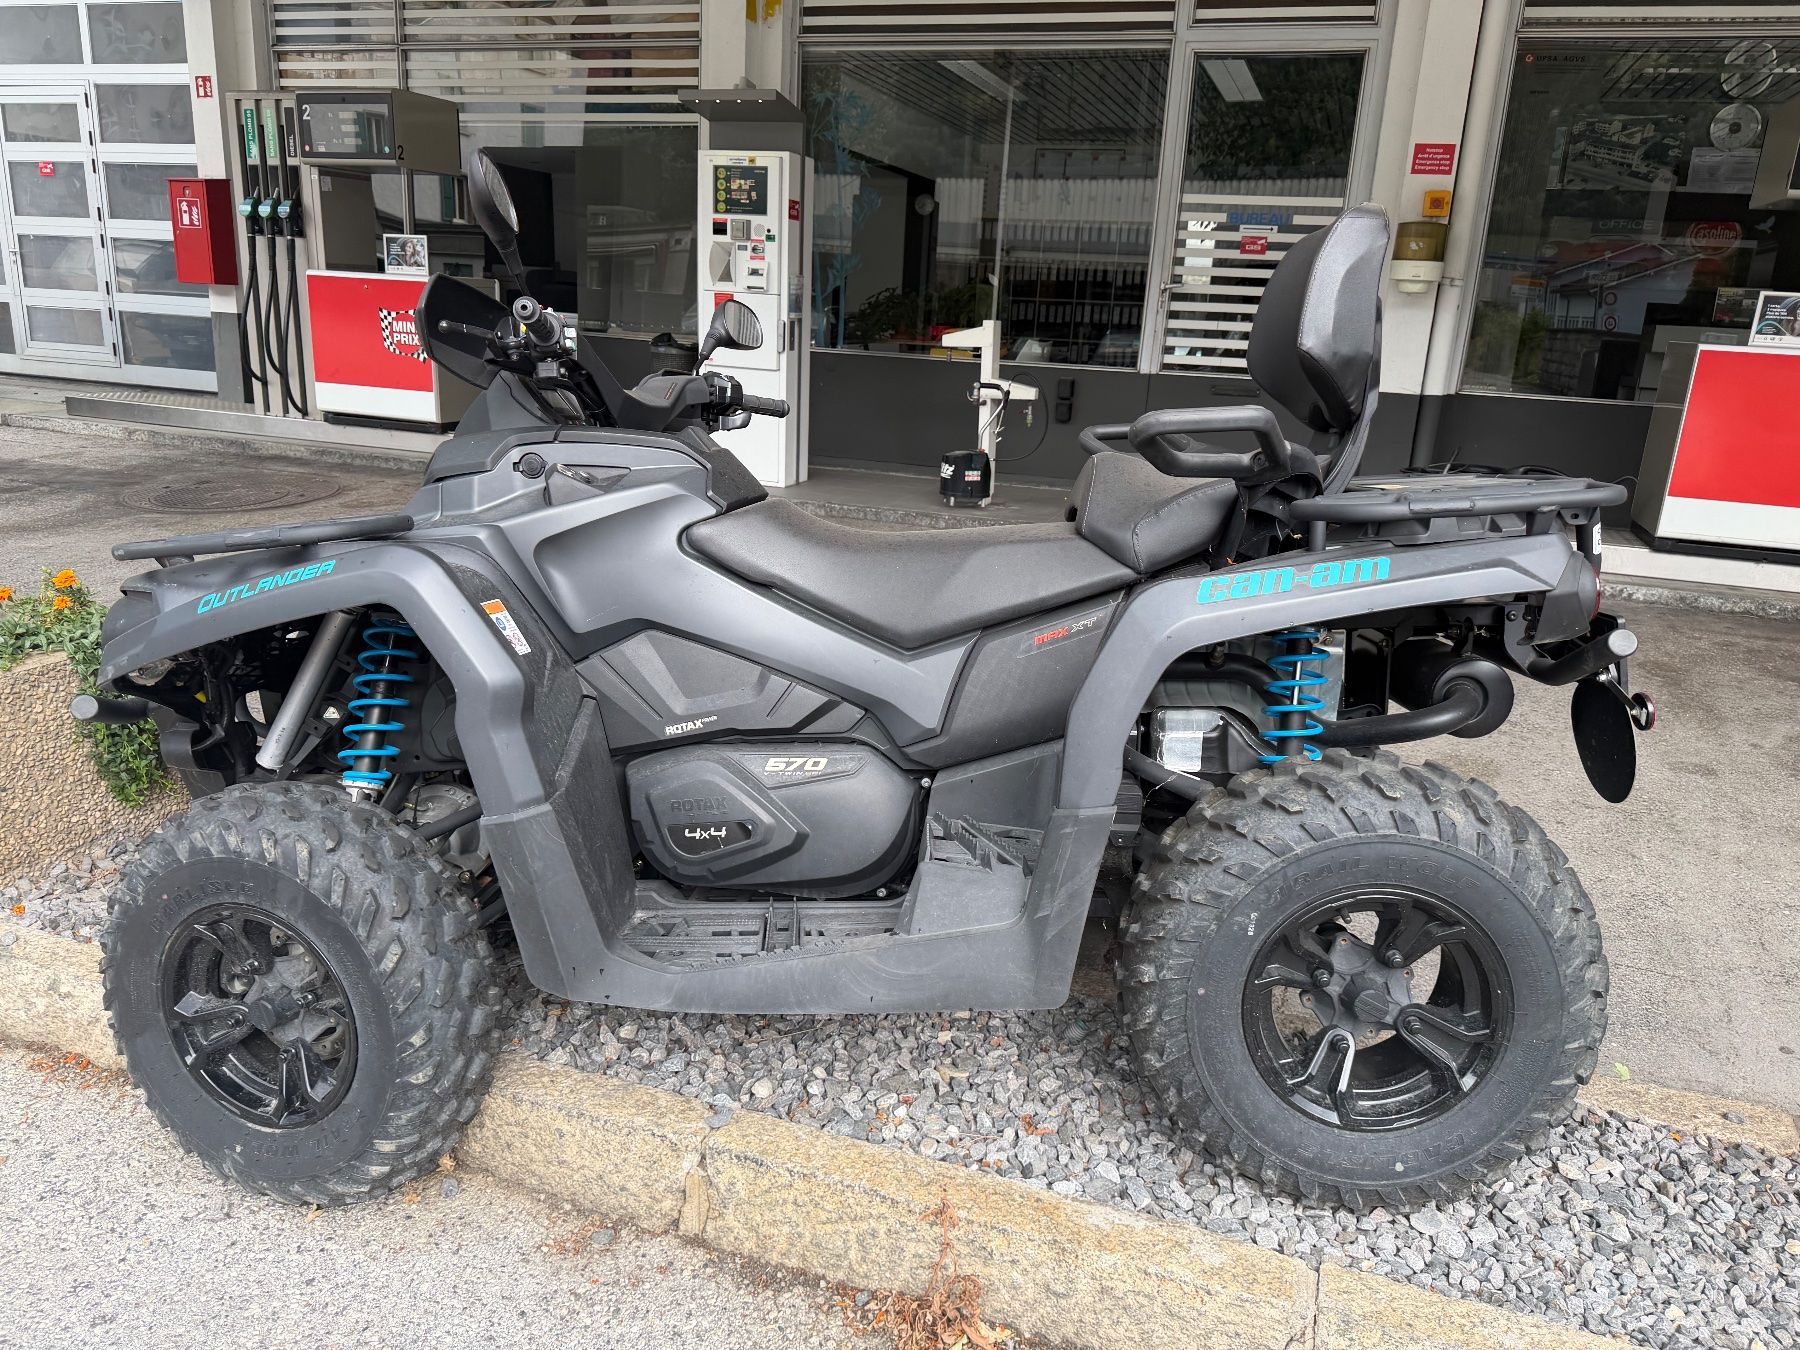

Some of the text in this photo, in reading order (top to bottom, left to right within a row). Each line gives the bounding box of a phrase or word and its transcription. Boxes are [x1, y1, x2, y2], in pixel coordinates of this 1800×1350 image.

[302, 104, 311, 120] 2
[397, 144, 405, 161] 2
[392, 320, 417, 333] MIN
[393, 334, 421, 346] PRIX
[197, 559, 337, 614] OUTLANDER
[664, 719, 703, 736] ROTAX
[764, 757, 829, 772] 570
[684, 826, 727, 840] 4x4
